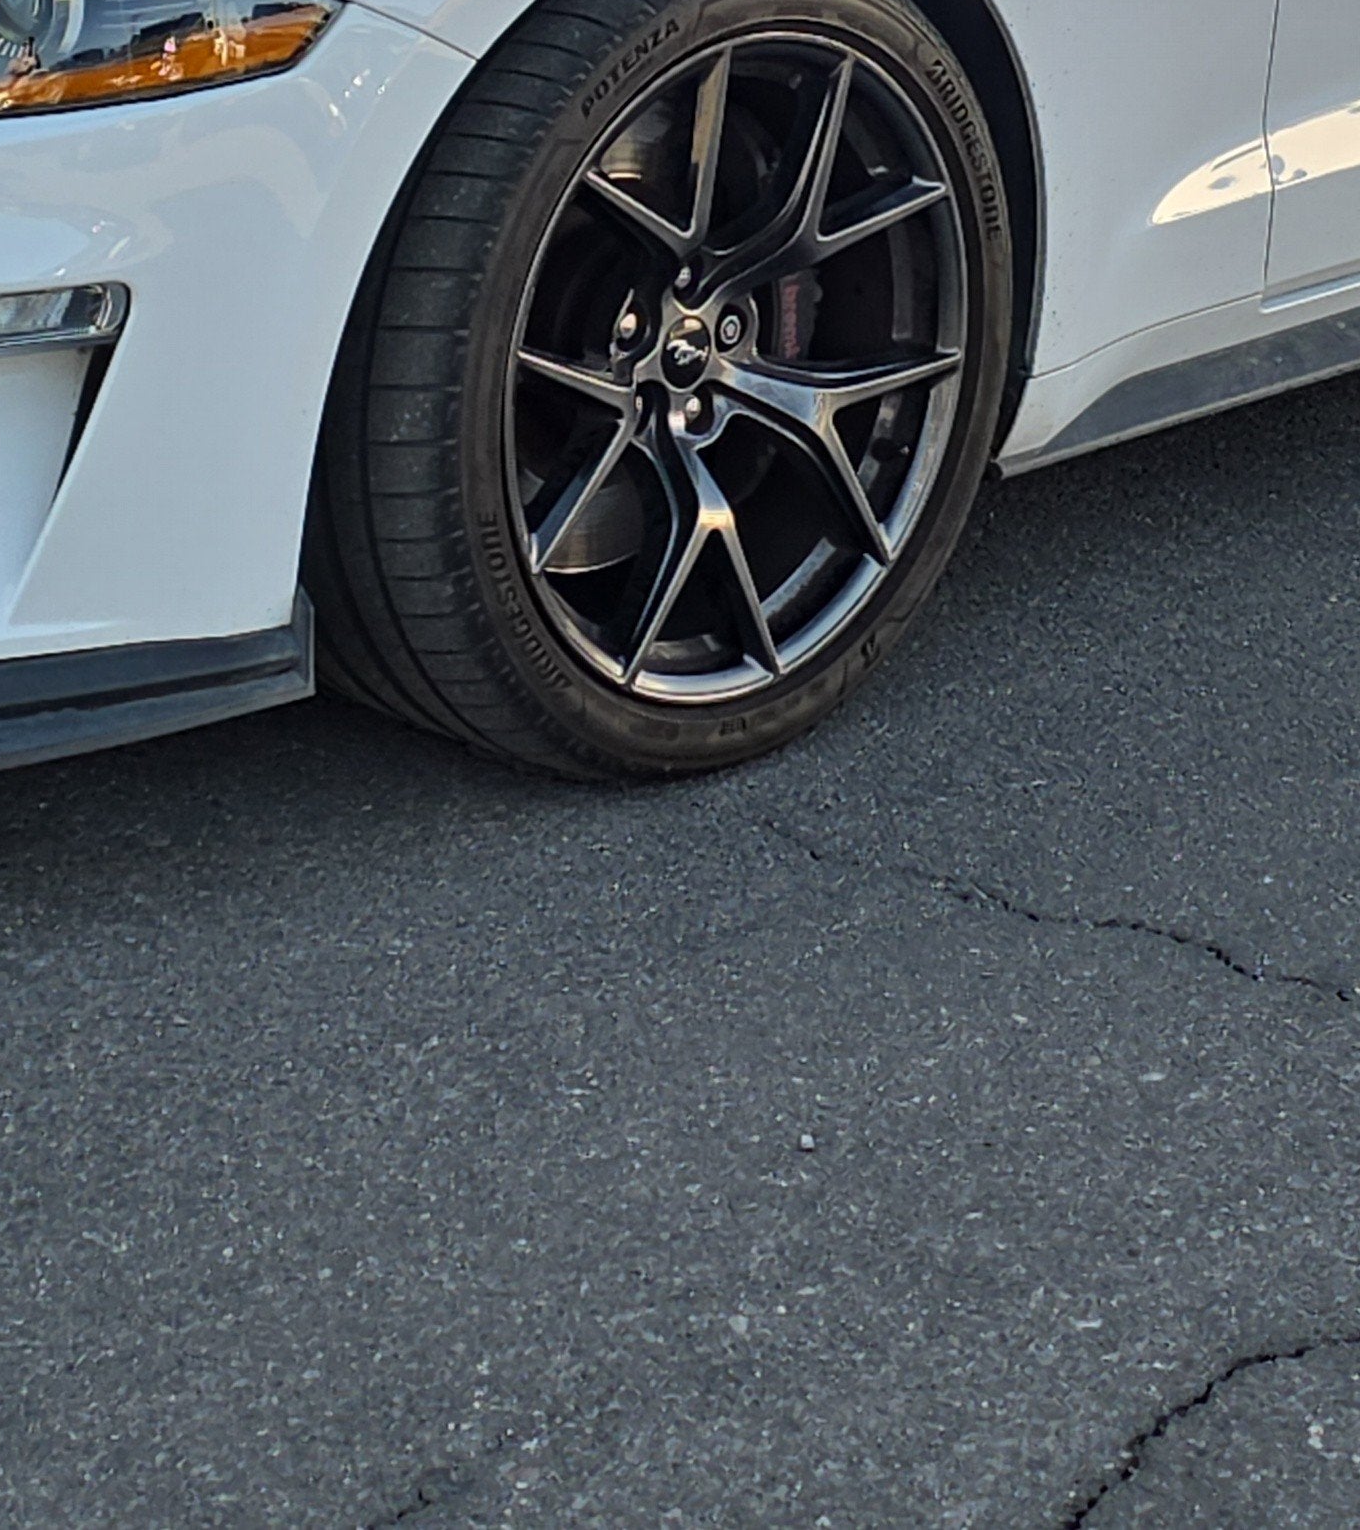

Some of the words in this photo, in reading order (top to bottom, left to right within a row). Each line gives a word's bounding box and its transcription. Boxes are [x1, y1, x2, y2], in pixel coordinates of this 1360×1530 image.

[580, 17, 680, 120] POTENZA
[926, 58, 1004, 242] BRIDGESTONE
[477, 511, 573, 690] BRIDGESTONE
